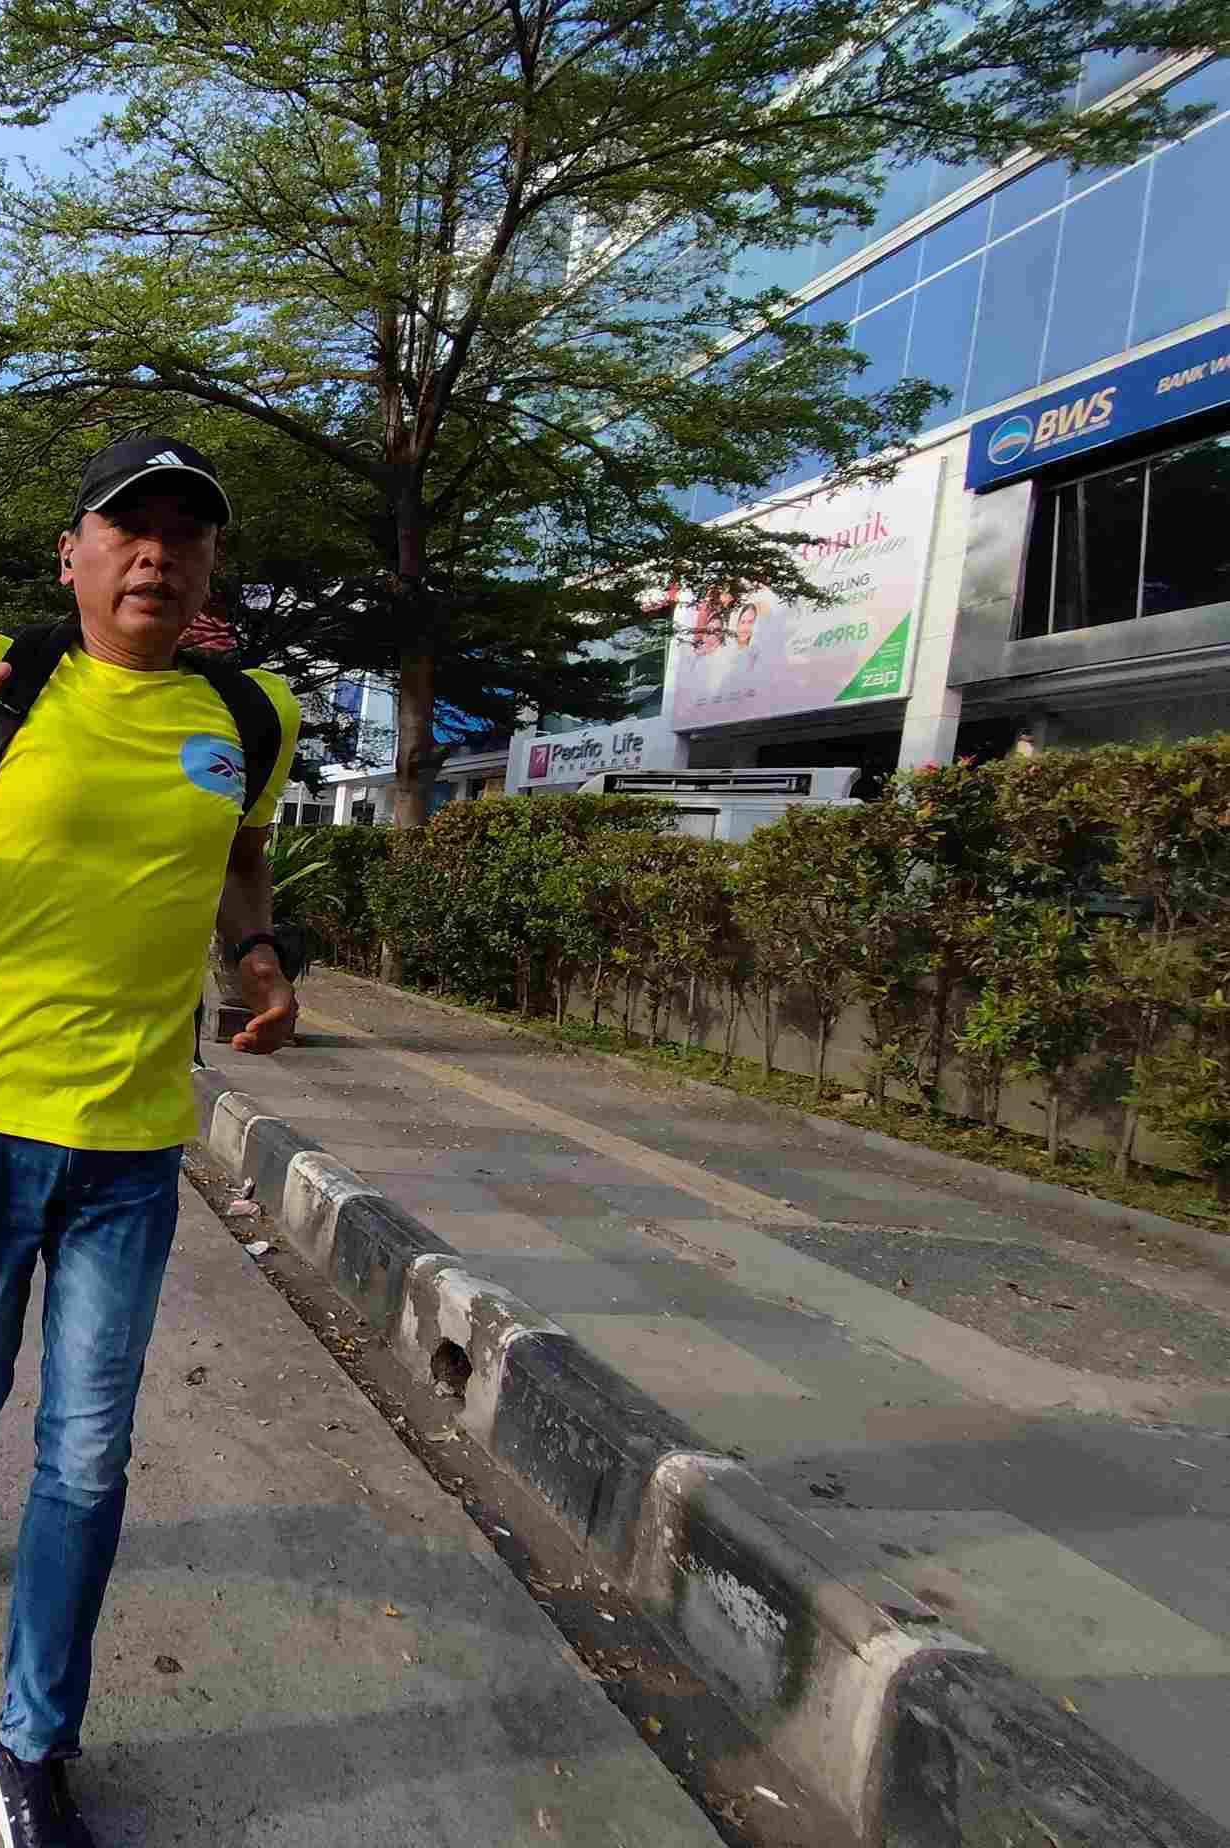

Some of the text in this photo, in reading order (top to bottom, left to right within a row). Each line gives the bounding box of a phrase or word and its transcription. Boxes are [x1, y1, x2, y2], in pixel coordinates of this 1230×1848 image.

[1156, 362, 1208, 395] BANK
[1033, 386, 1118, 444] BWS
[552, 732, 644, 762] Pacific Life
